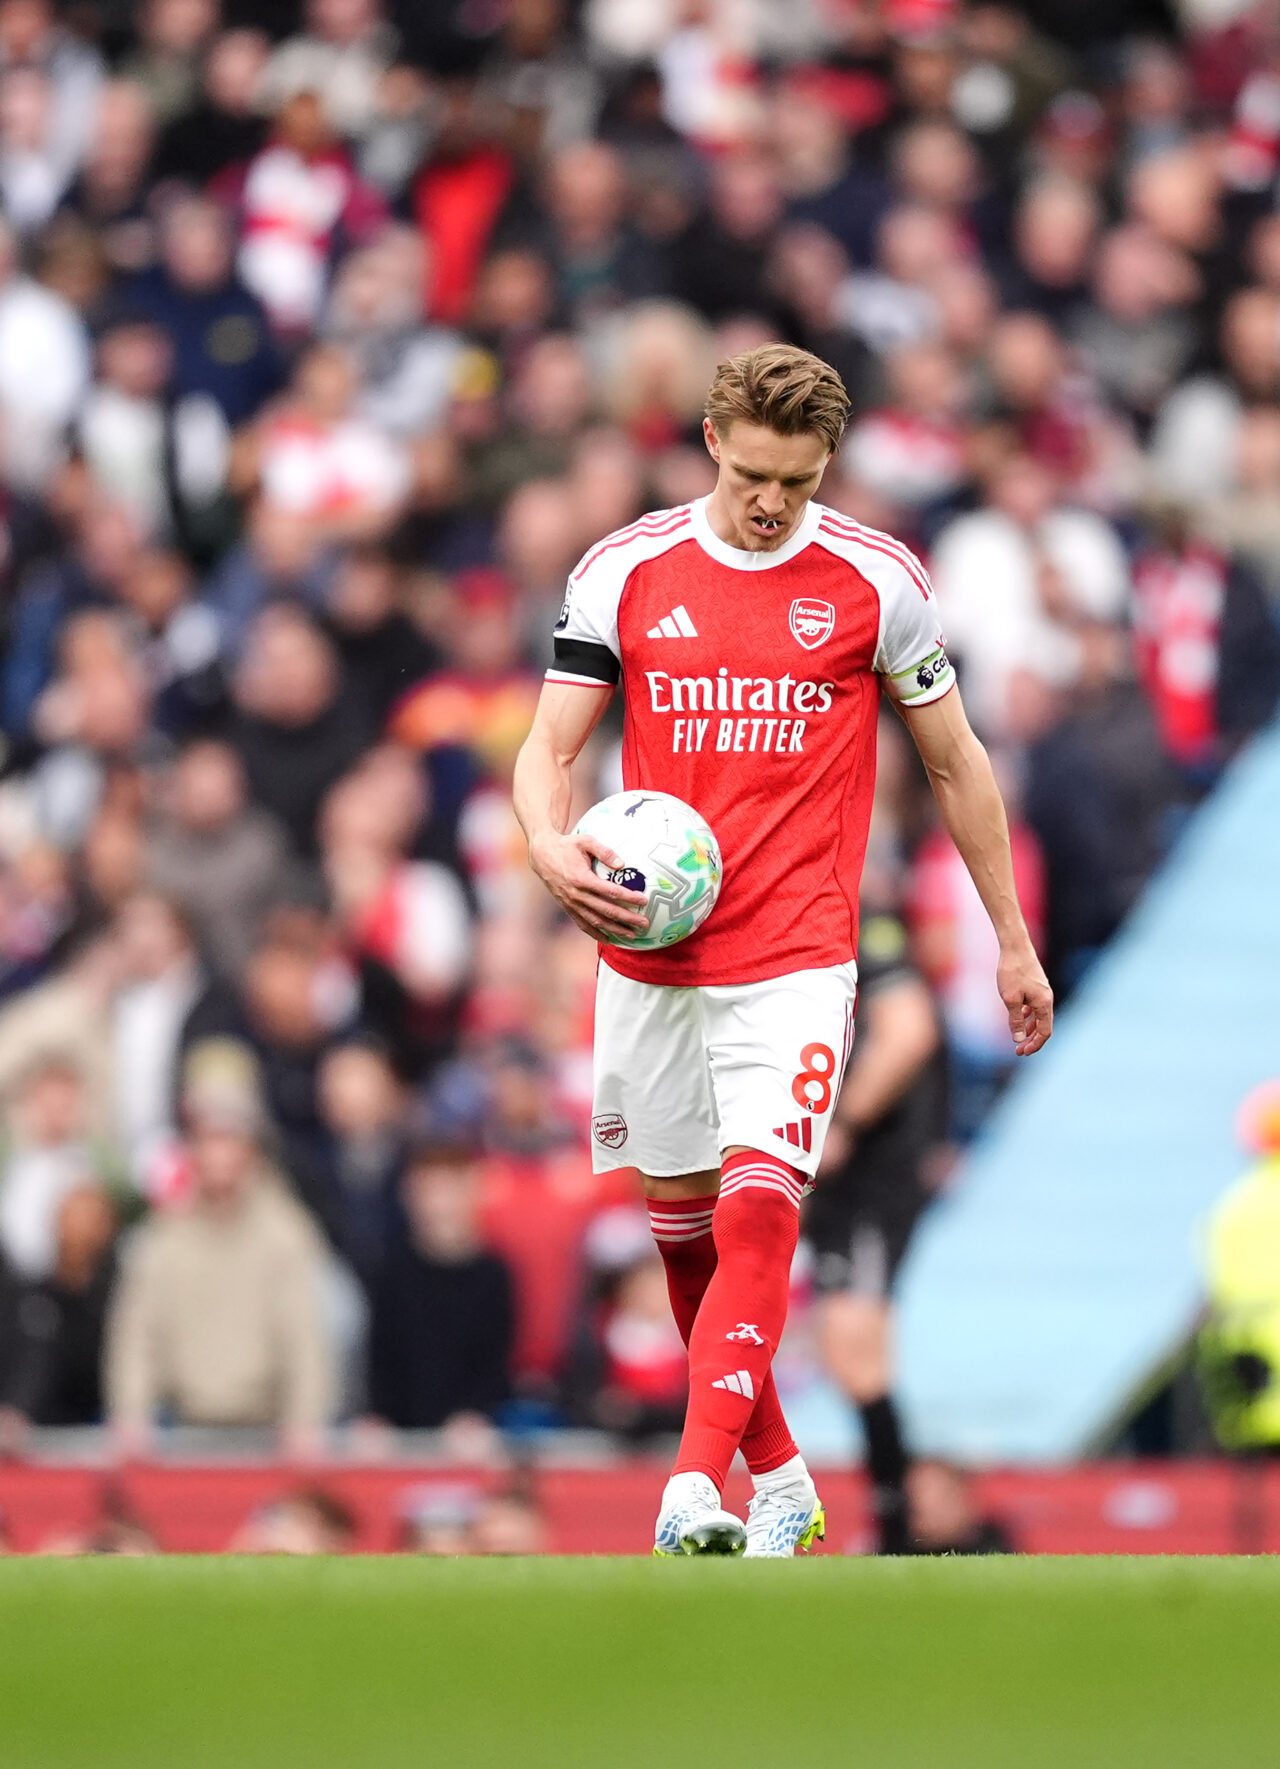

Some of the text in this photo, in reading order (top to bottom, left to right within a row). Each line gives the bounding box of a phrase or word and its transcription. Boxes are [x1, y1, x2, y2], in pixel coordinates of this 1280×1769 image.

[796, 606, 829, 618] Arsenal
[644, 667, 835, 712] Emirates
[672, 718, 806, 753] FLY BETTER
[792, 1042, 835, 1114] 8
